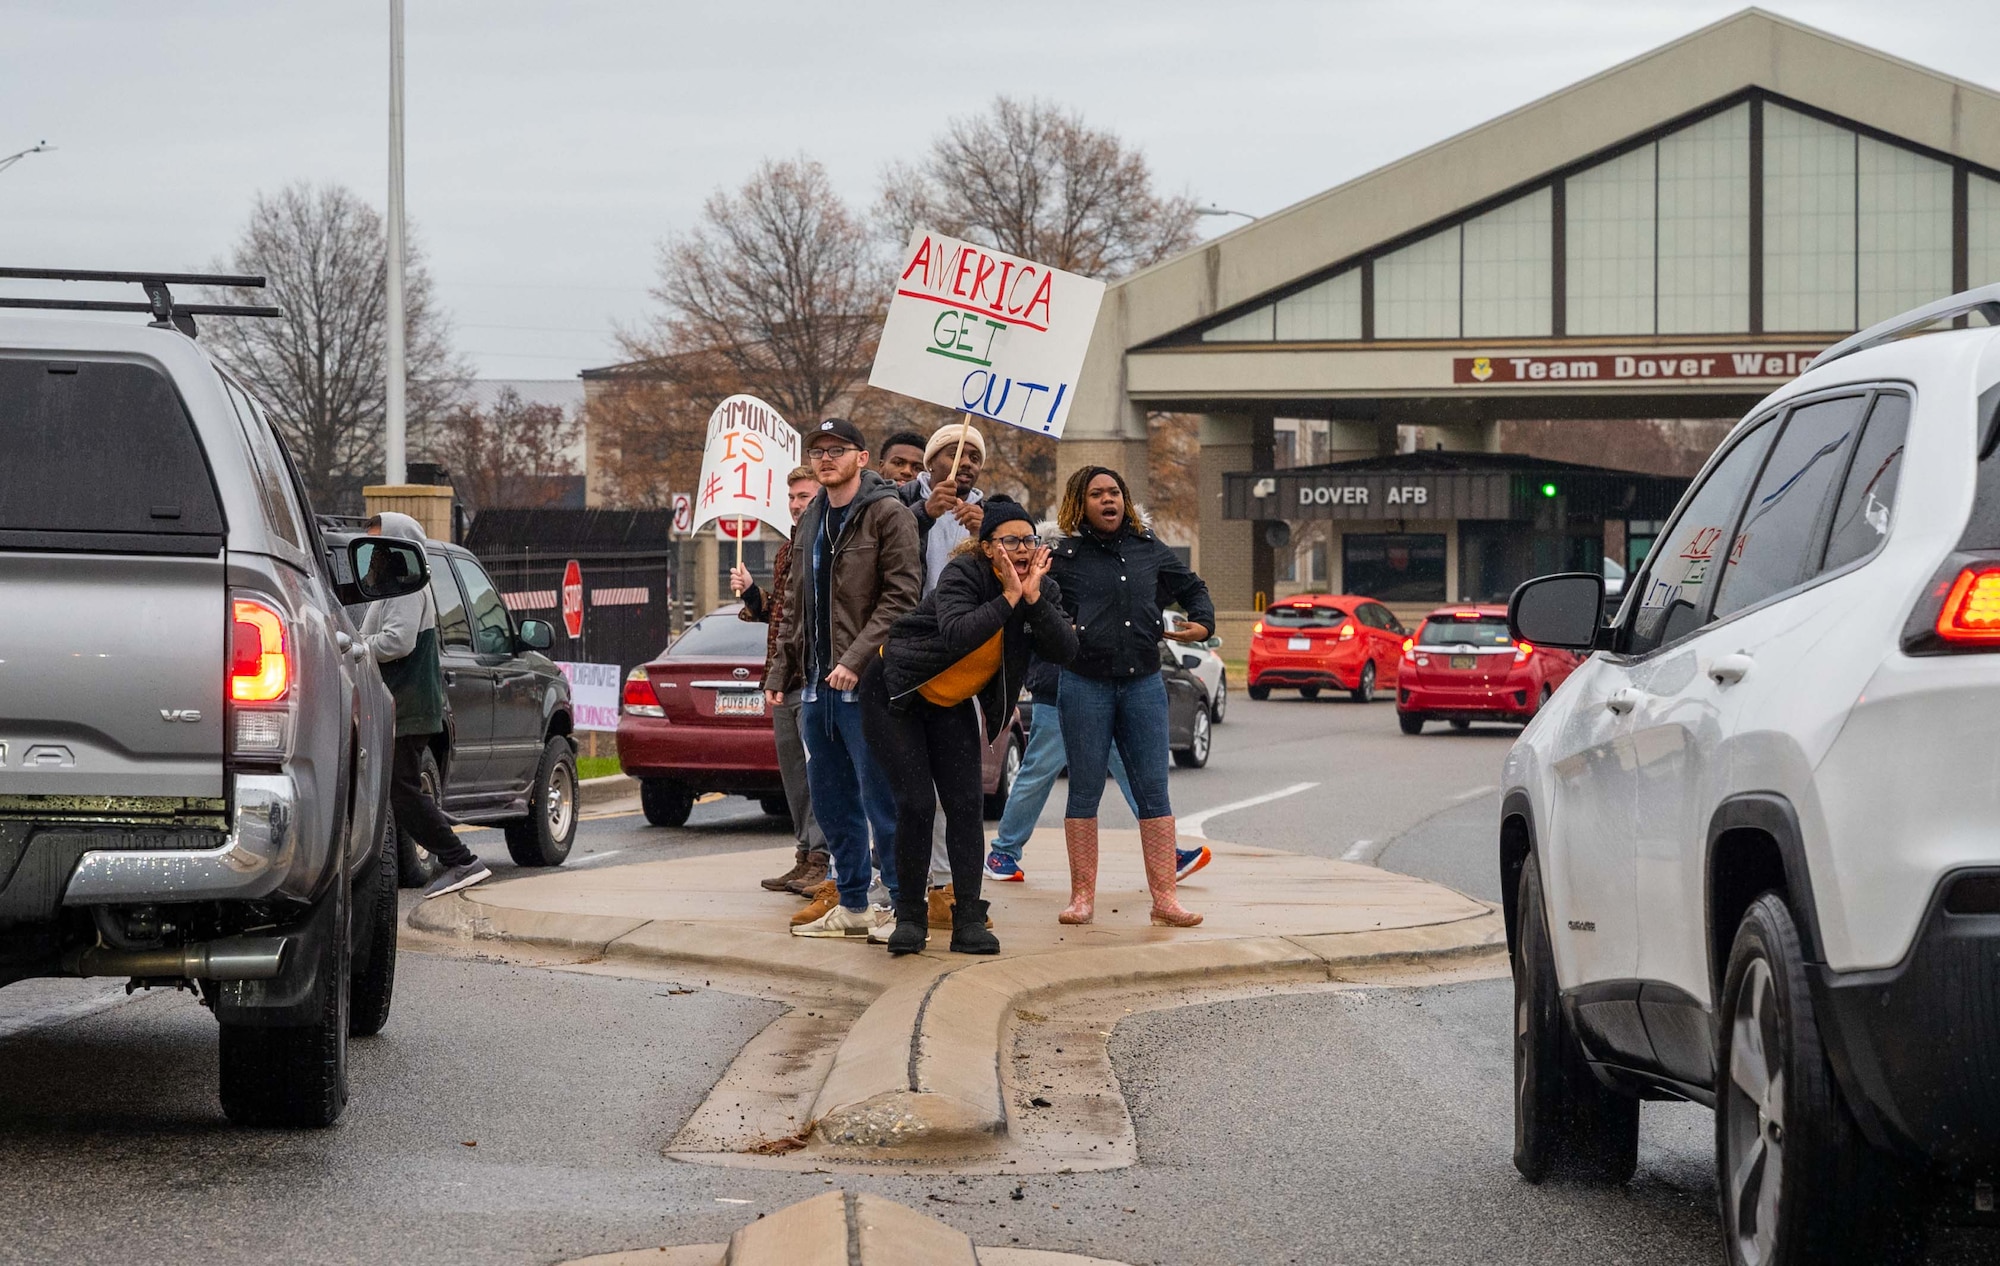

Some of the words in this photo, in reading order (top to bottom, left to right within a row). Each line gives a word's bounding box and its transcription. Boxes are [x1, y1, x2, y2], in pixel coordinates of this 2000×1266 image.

[902, 236, 1053, 324] AMERICA
[934, 311, 1007, 361] GET
[1510, 358, 1598, 380] Team
[1615, 355, 1715, 378] Dover
[962, 370, 1067, 431] OUT!
[706, 400, 796, 462] COMMUNISM
[720, 432, 764, 462] IS
[1300, 487, 1368, 504] DOVER
[1387, 487, 1428, 504] AFB
[725, 521, 752, 531] ENER
[160, 709, 201, 722] V6
